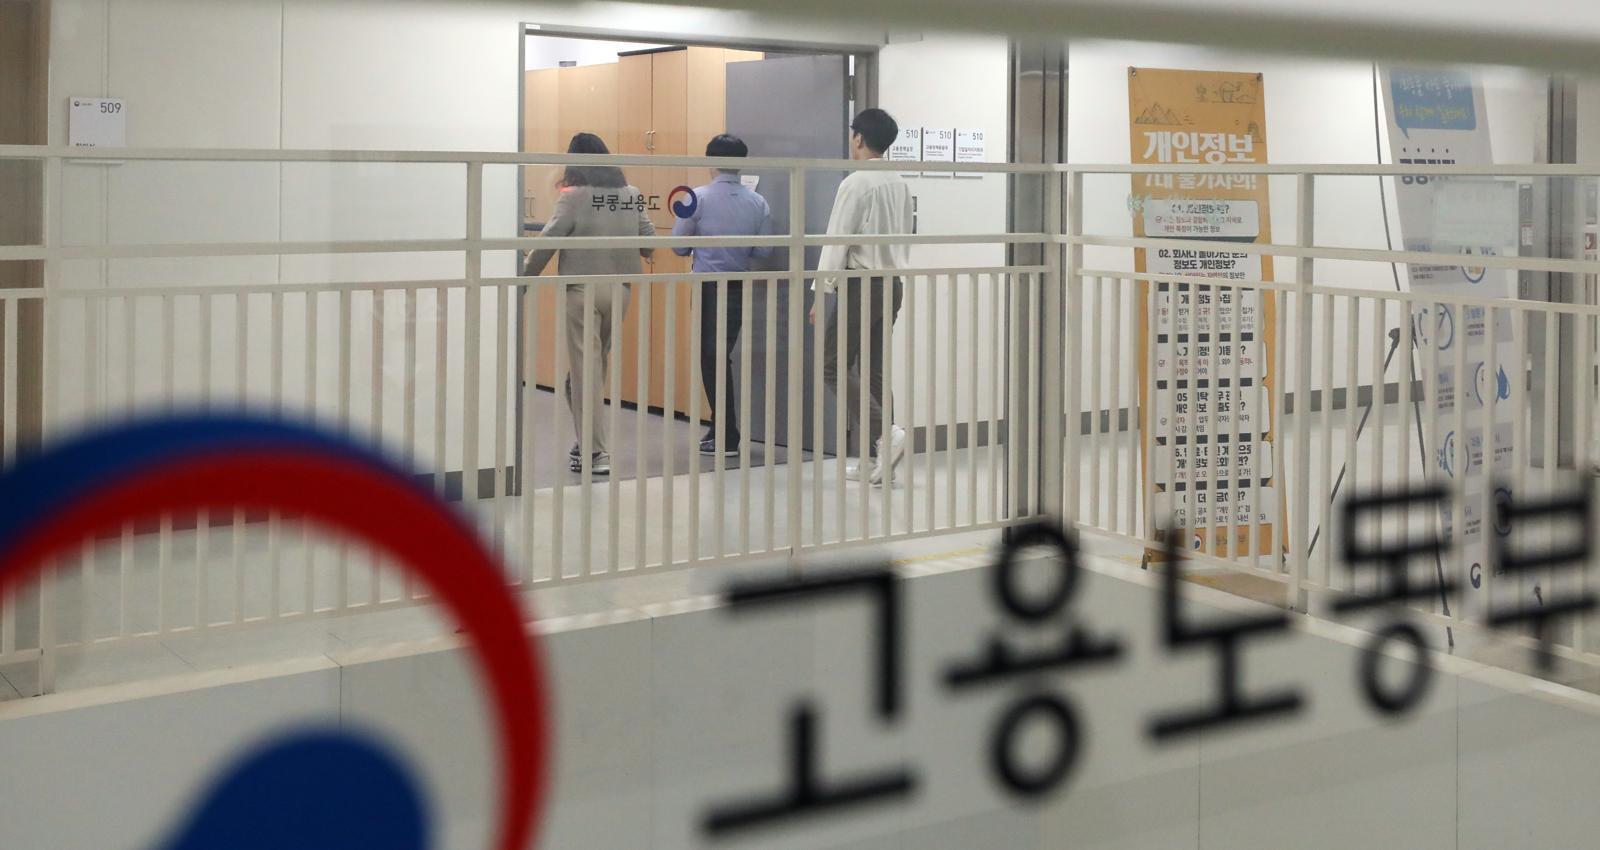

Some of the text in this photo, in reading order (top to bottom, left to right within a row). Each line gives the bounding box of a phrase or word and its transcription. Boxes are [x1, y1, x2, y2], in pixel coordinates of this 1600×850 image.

[100, 102, 121, 113] 509
[906, 129, 918, 139] 510
[939, 130, 952, 140] 510
[972, 132, 984, 141] 510
[1143, 131, 1256, 164] 개인정보
[1158, 249, 1171, 258] 02.
[1173, 259, 1235, 270] 정보도 개인정보?
[700, 466, 1600, 838] 고용노동부
